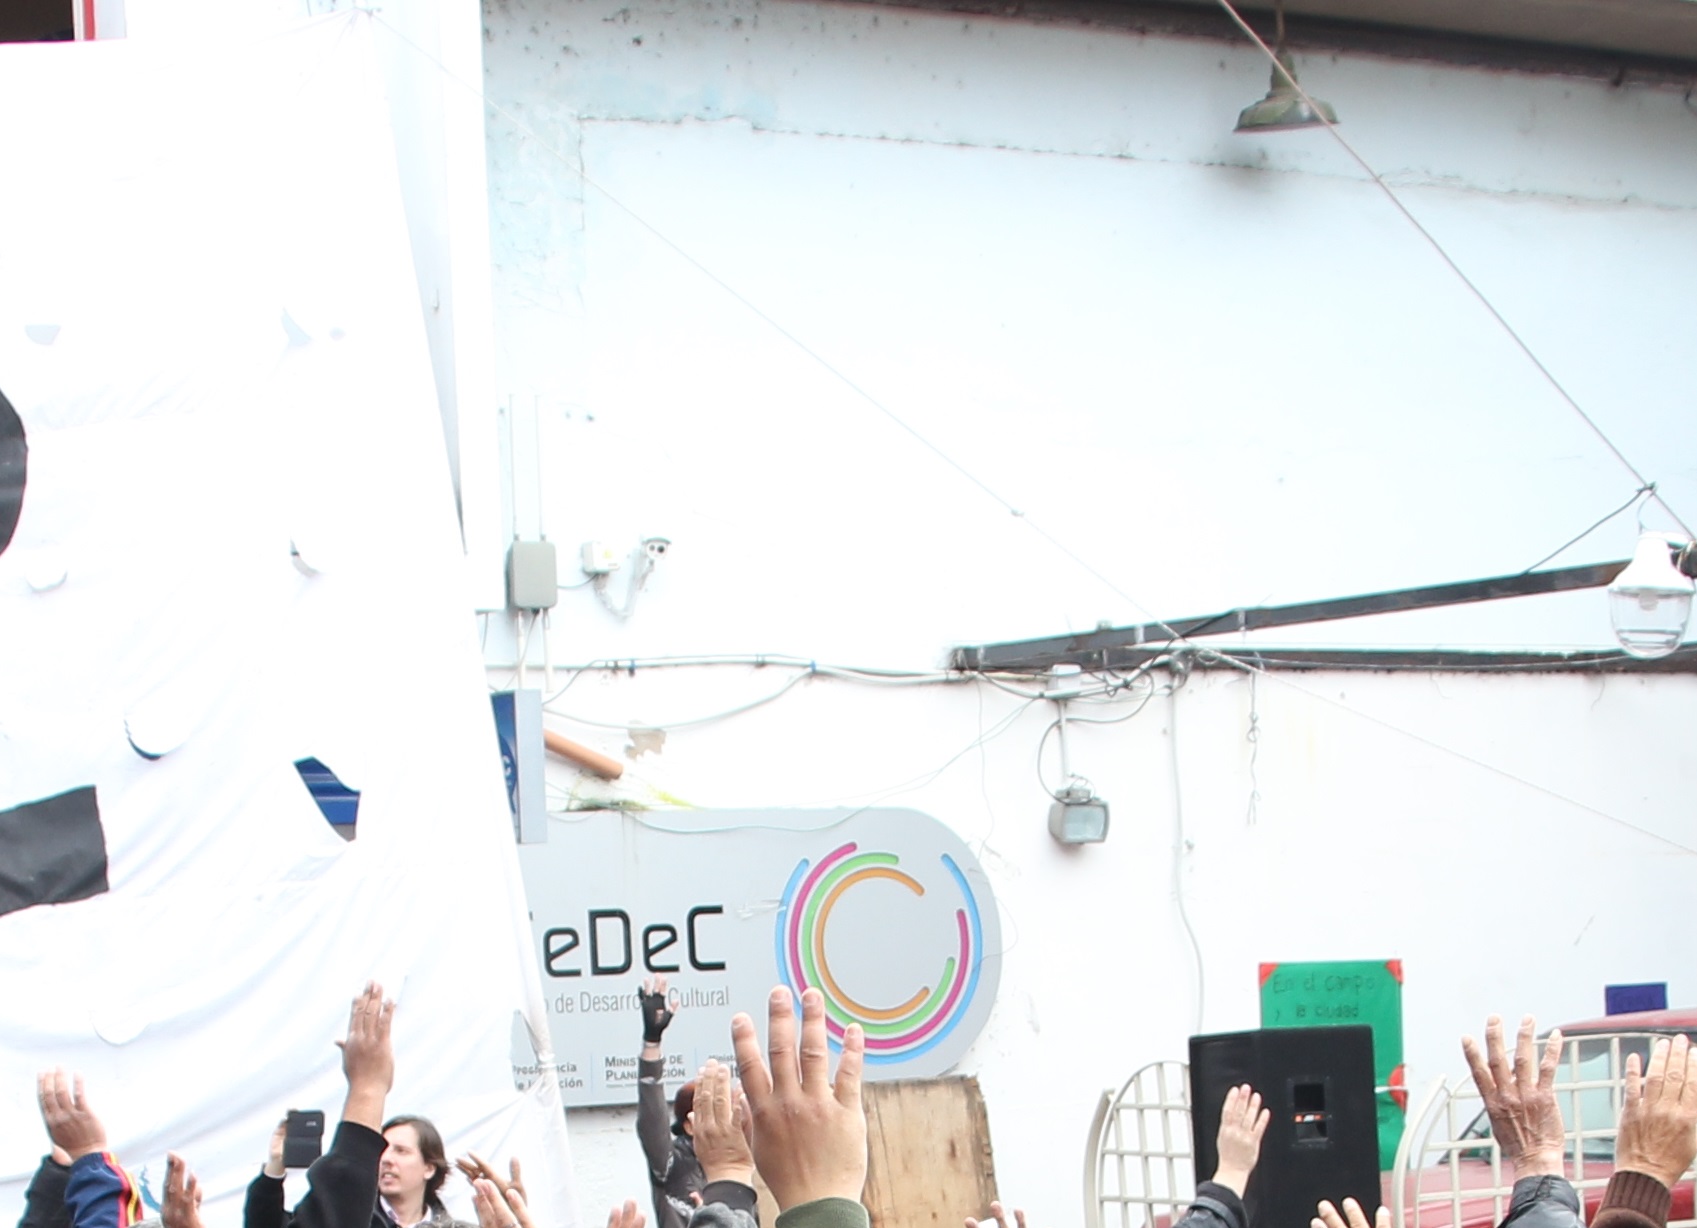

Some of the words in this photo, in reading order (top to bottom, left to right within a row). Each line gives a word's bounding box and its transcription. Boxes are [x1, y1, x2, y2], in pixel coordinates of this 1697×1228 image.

[529, 904, 726, 977] eDeC
[555, 993, 575, 1015] de
[580, 990, 645, 1013] Desarro
[667, 986, 730, 1010] Cultural
